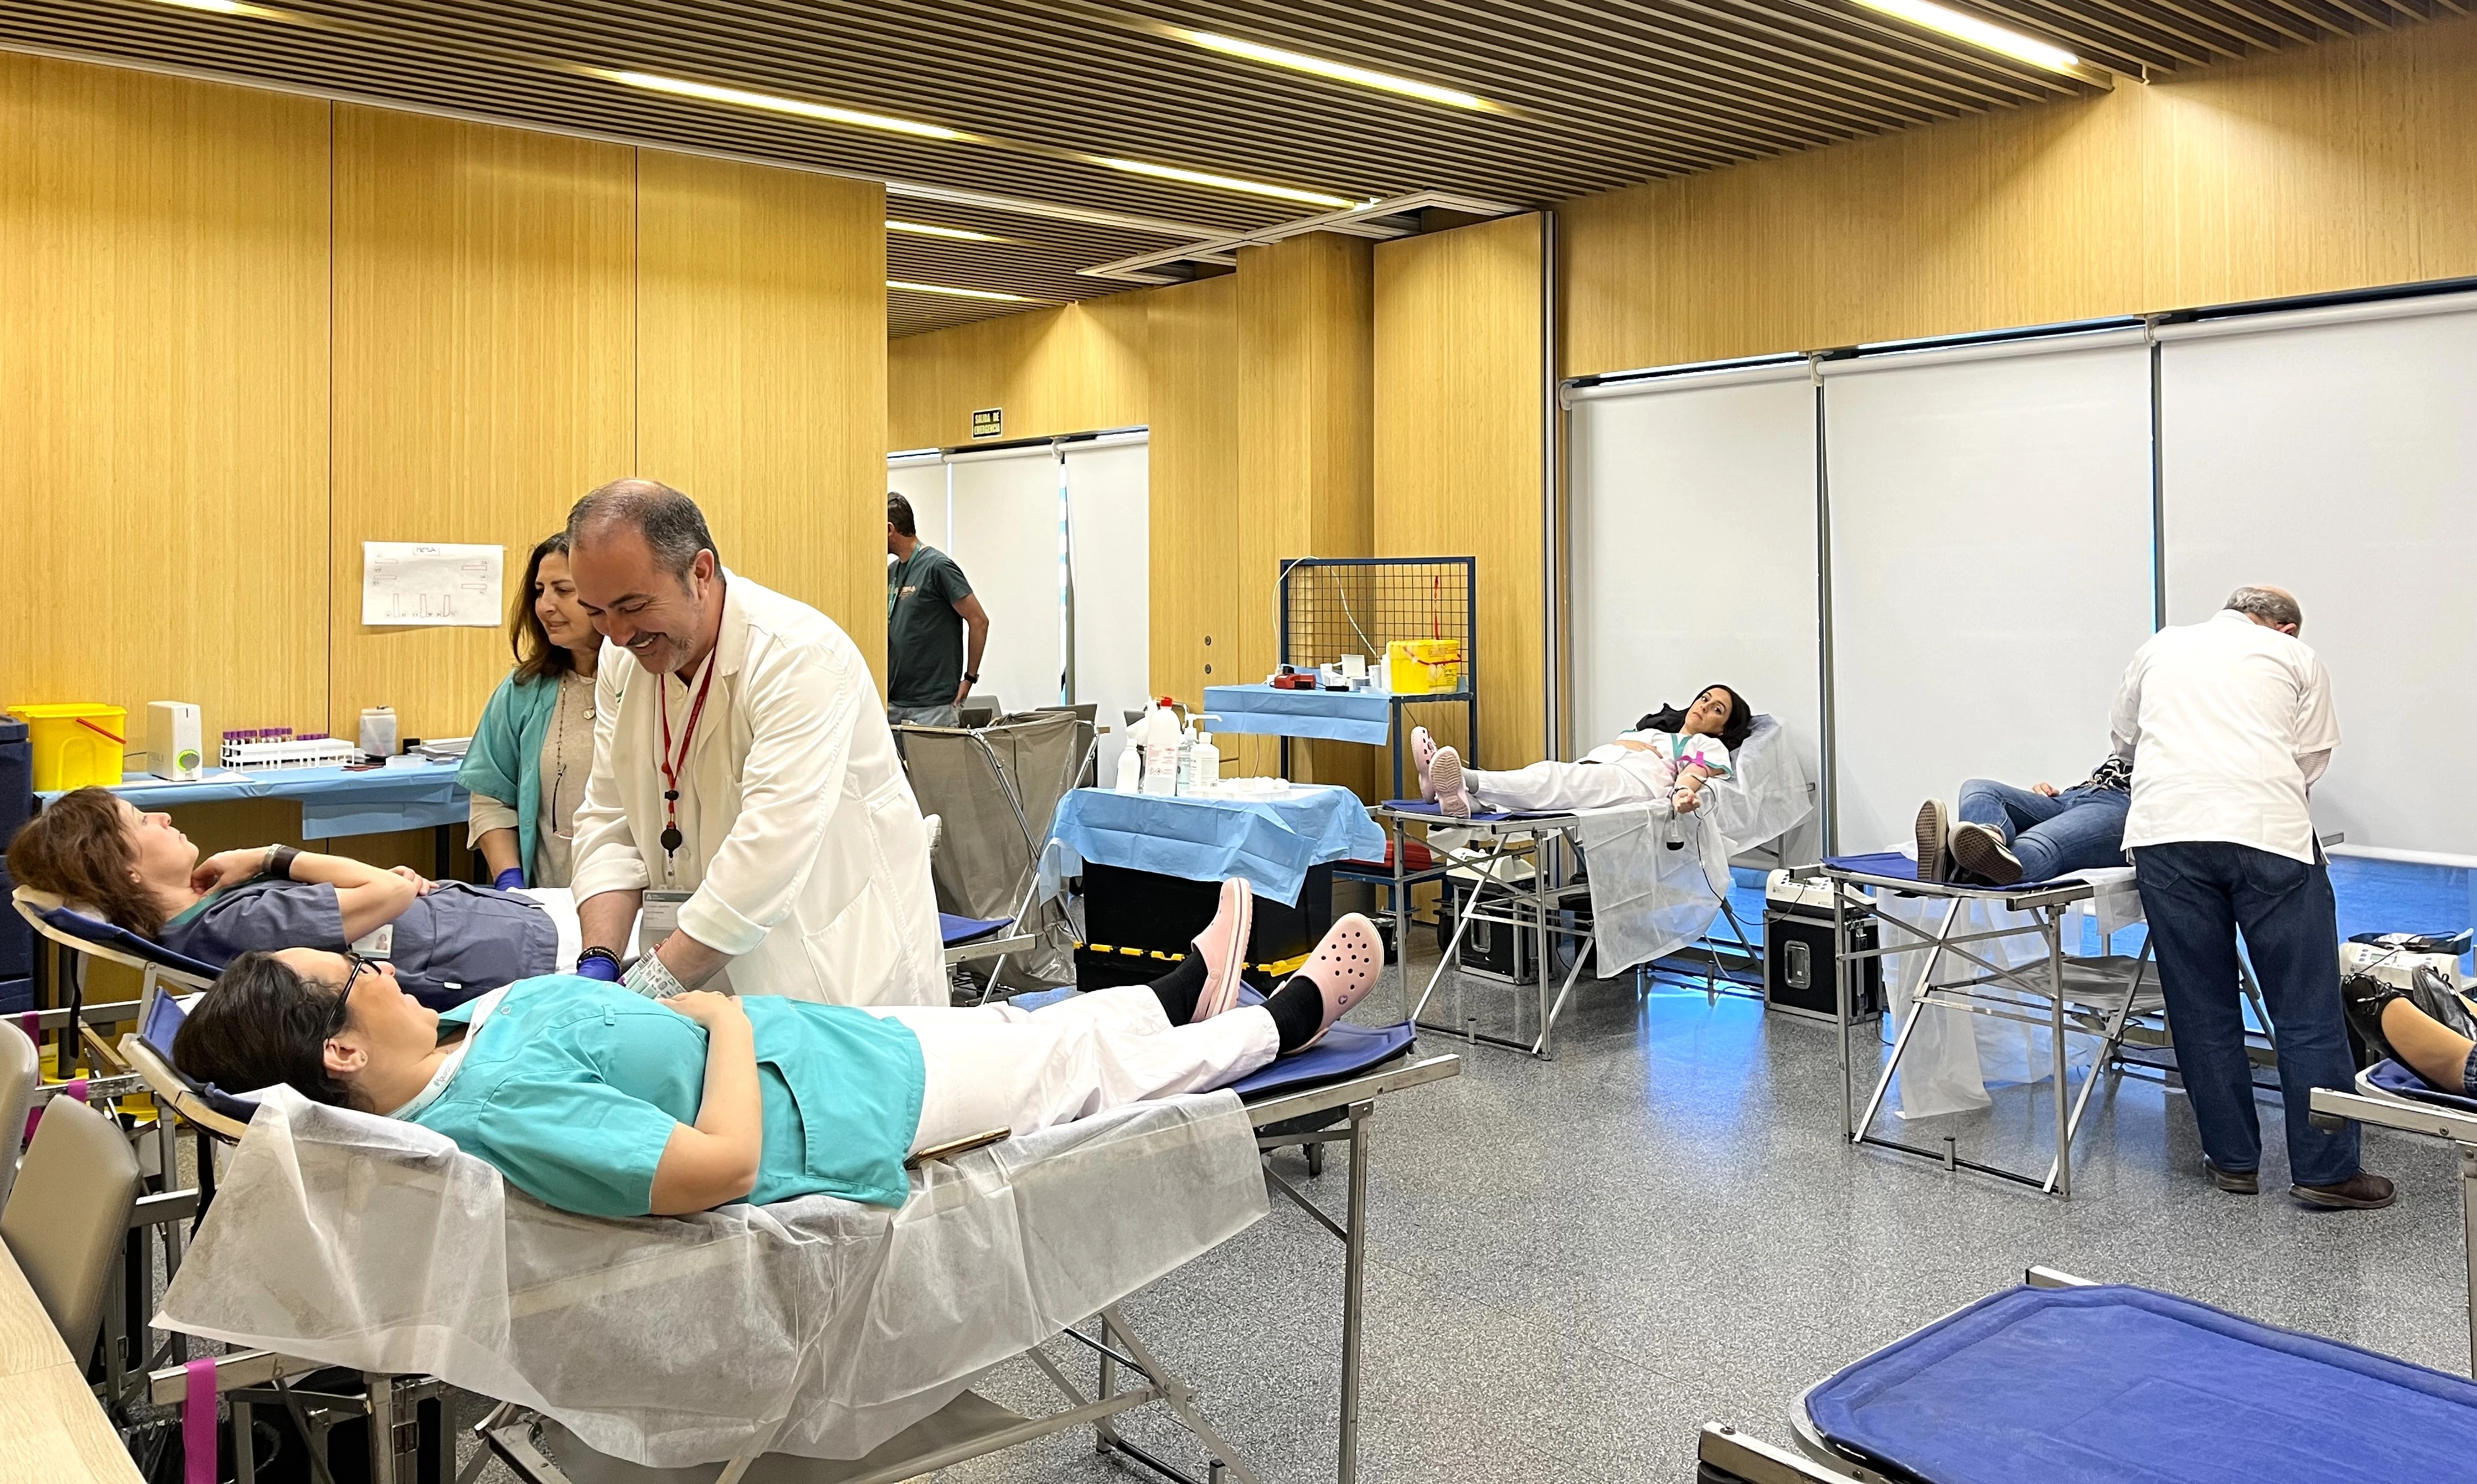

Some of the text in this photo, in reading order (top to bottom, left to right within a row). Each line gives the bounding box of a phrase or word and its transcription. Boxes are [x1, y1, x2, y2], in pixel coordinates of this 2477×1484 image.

[975, 411, 999, 424] SALIDA DE
[974, 422, 1001, 435] EMERGENCIA
